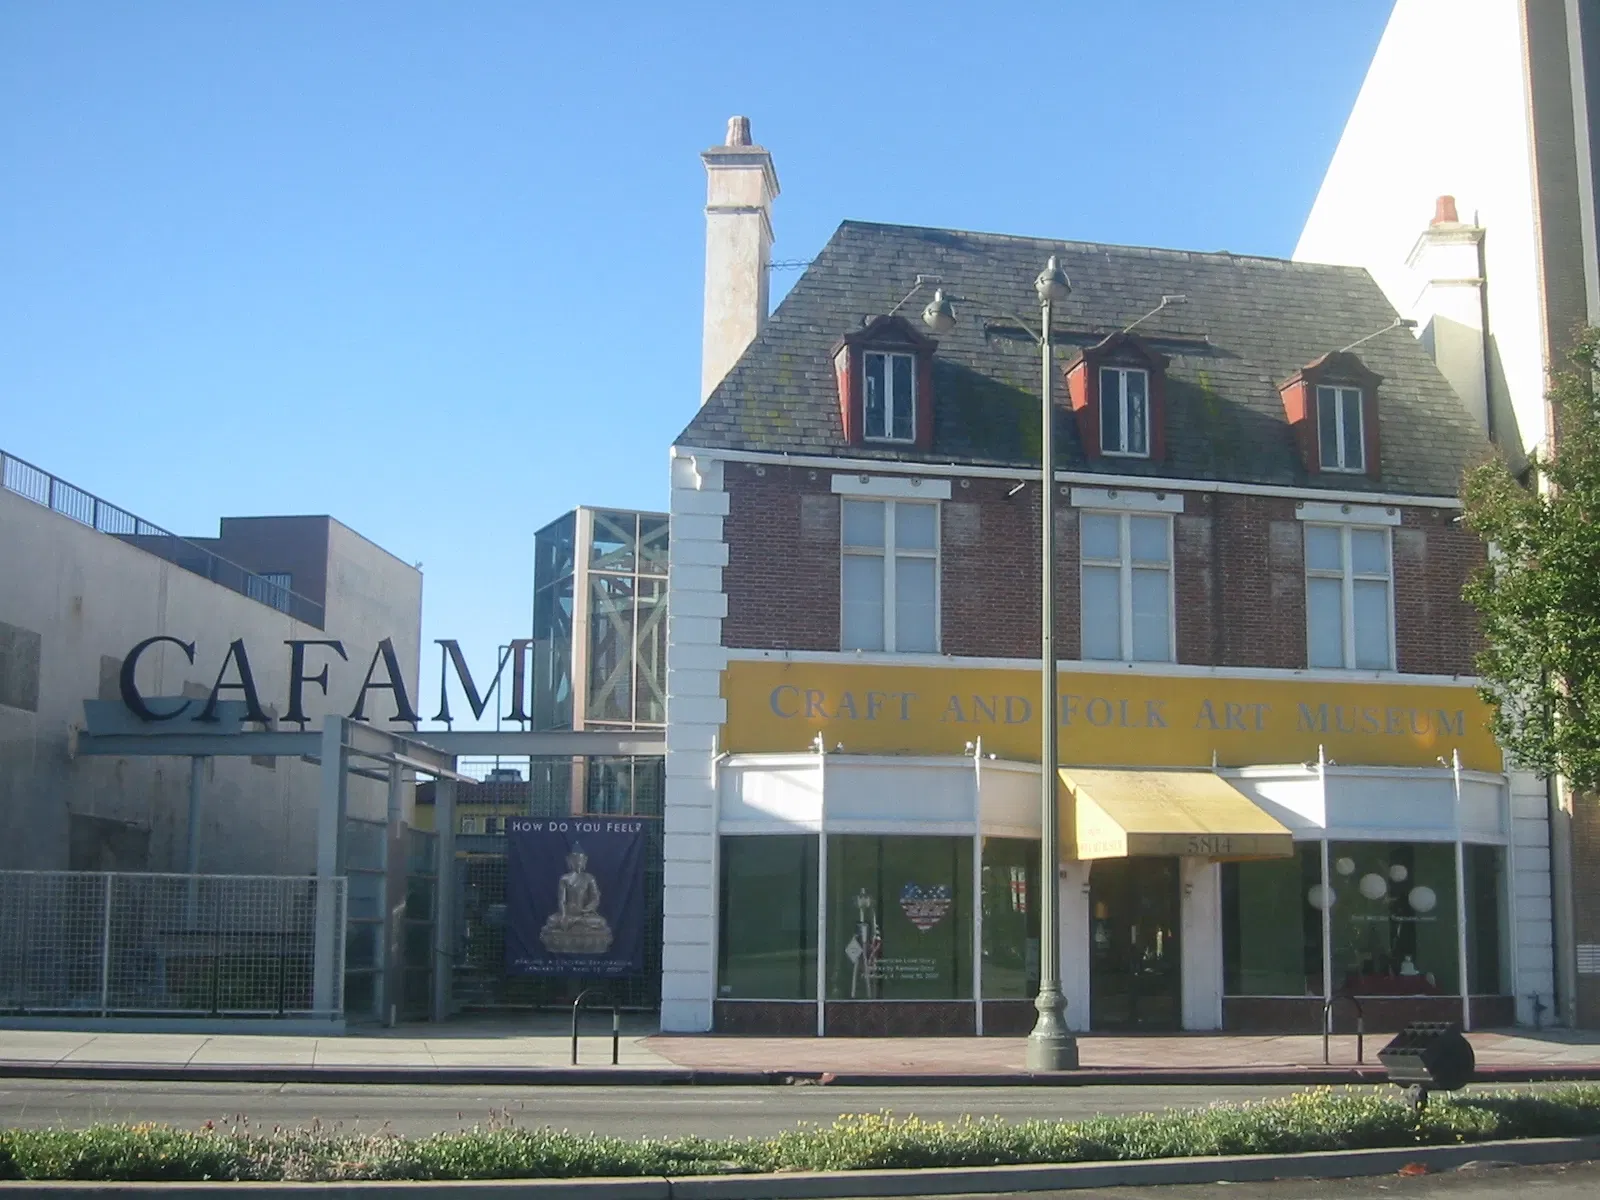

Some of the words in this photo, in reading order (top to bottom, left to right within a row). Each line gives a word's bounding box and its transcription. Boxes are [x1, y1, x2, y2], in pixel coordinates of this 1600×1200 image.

[119, 635, 535, 722] CAFAM
[769, 684, 917, 722] CRAFT
[939, 694, 1033, 725] AND
[1060, 694, 1169, 729] FOLK
[1193, 699, 1272, 731] ART
[1295, 702, 1465, 737] MUSEUM
[512, 821, 543, 832] HOW
[548, 821, 569, 832] DO
[574, 822, 601, 832] YOU
[606, 822, 642, 833] FEEL?
[1188, 836, 1233, 854] 5814
